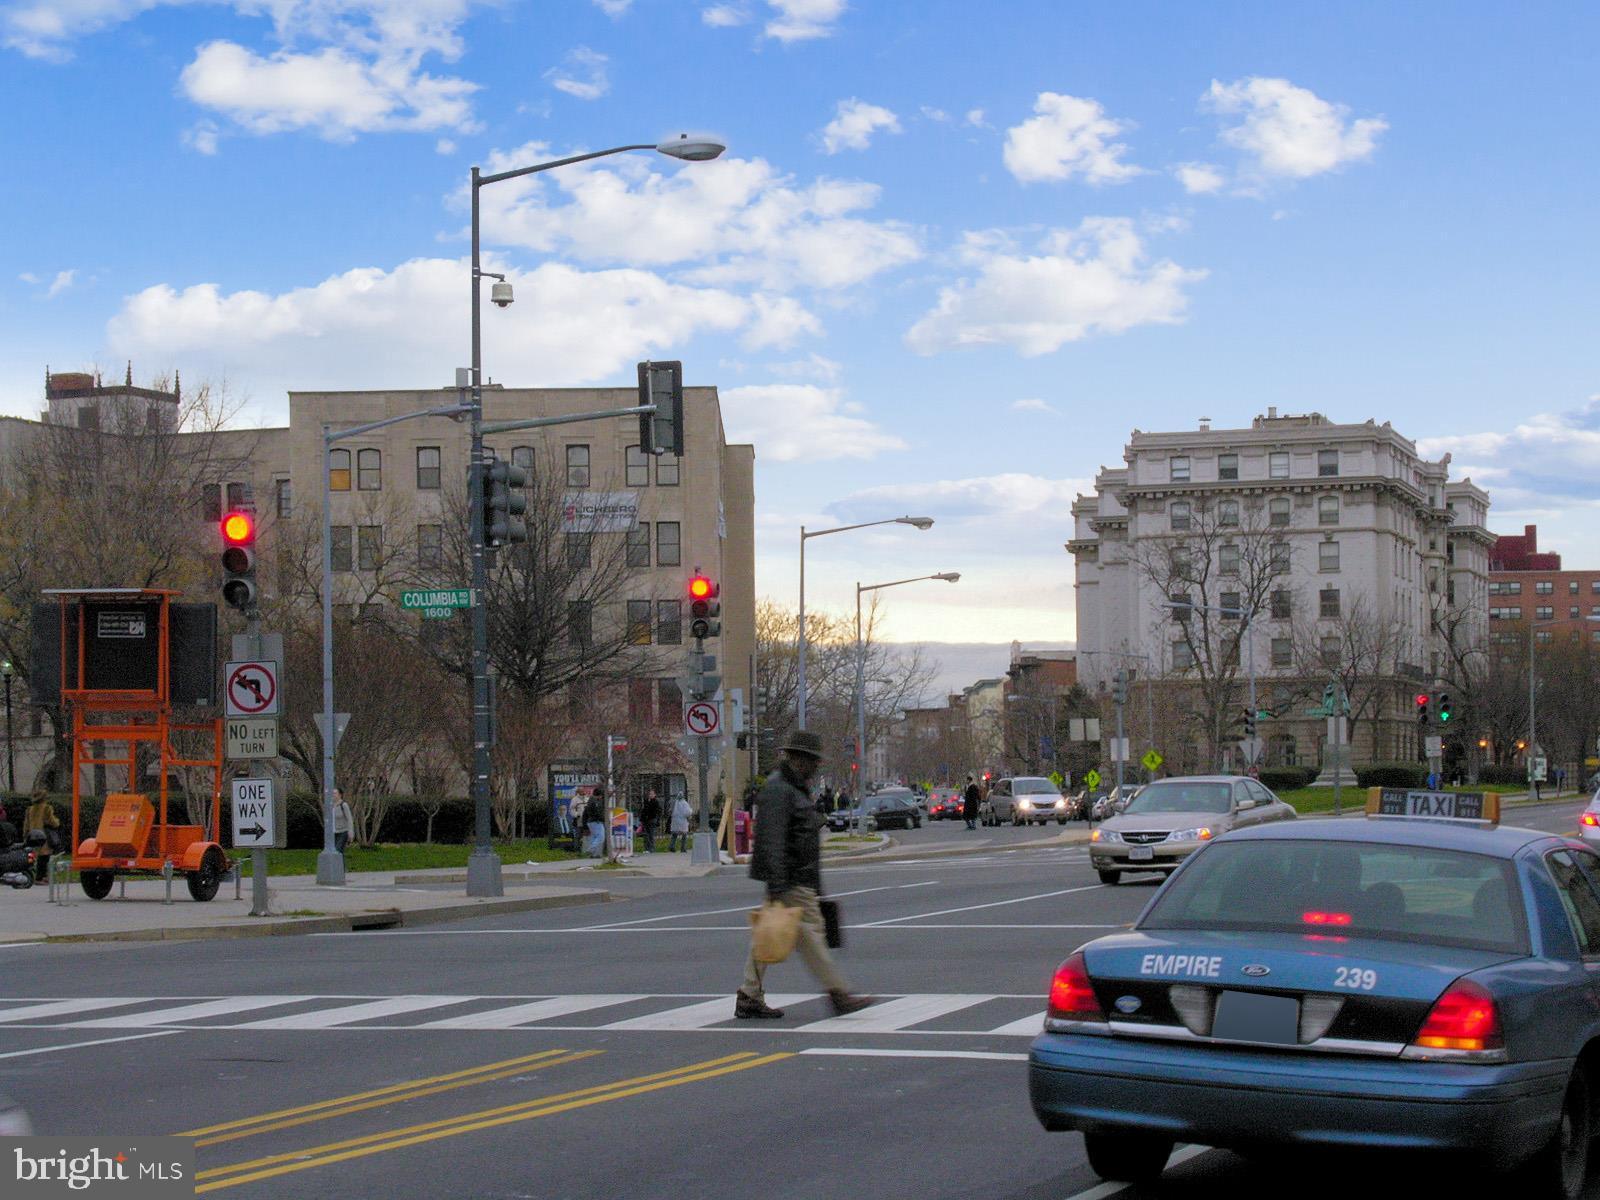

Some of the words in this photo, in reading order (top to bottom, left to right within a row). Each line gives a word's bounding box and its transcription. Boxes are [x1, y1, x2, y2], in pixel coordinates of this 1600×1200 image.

[404, 592, 458, 606] COLUMBIA
[425, 608, 452, 617] 1600
[229, 724, 247, 740] NO
[253, 728, 275, 739] LEFT
[240, 743, 265, 753] TURN
[239, 785, 265, 800] ONE
[239, 803, 268, 818] WAY
[1409, 795, 1452, 816] TAXI
[1140, 954, 1223, 977] EMPIRE
[1334, 966, 1377, 990] 239
